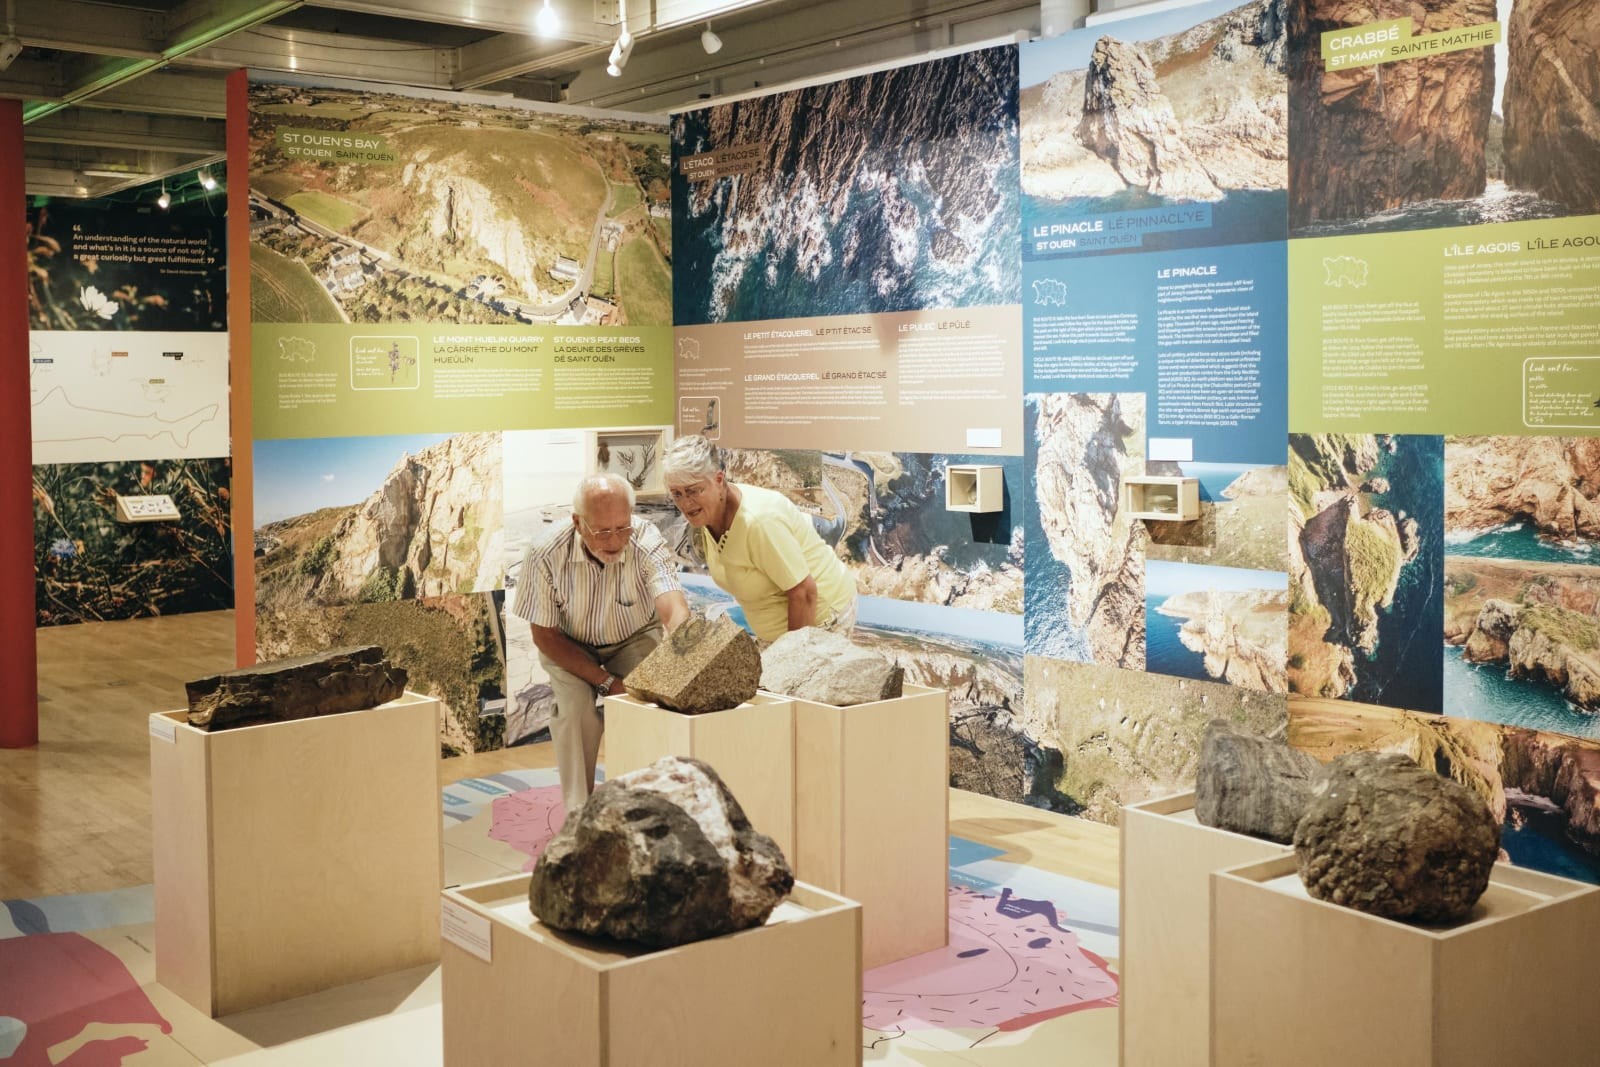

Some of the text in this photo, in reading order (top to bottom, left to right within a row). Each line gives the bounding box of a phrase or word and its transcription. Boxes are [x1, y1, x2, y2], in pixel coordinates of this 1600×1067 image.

[1330, 24, 1400, 50] CRABBÉ
[1330, 29, 1494, 66] ST MARY SAINTE MATHIE
[283, 133, 380, 149] ST OUEN'S BAY
[303, 148, 332, 157] OUEN
[336, 150, 364, 160] SAINT
[1034, 226, 1048, 238] LE
[1050, 220, 1103, 236] PINACLE
[85, 235, 138, 244] understanding
[1036, 241, 1048, 250] ST
[1049, 239, 1076, 250] OUEN
[1080, 236, 1108, 246] SAINT
[1476, 242, 1520, 254] AGOIS
[1527, 238, 1558, 250] L'ÎLE
[101, 254, 132, 262] curiosity
[1158, 266, 1217, 278] LE PINACLE
[753, 331, 770, 339] PETIT
